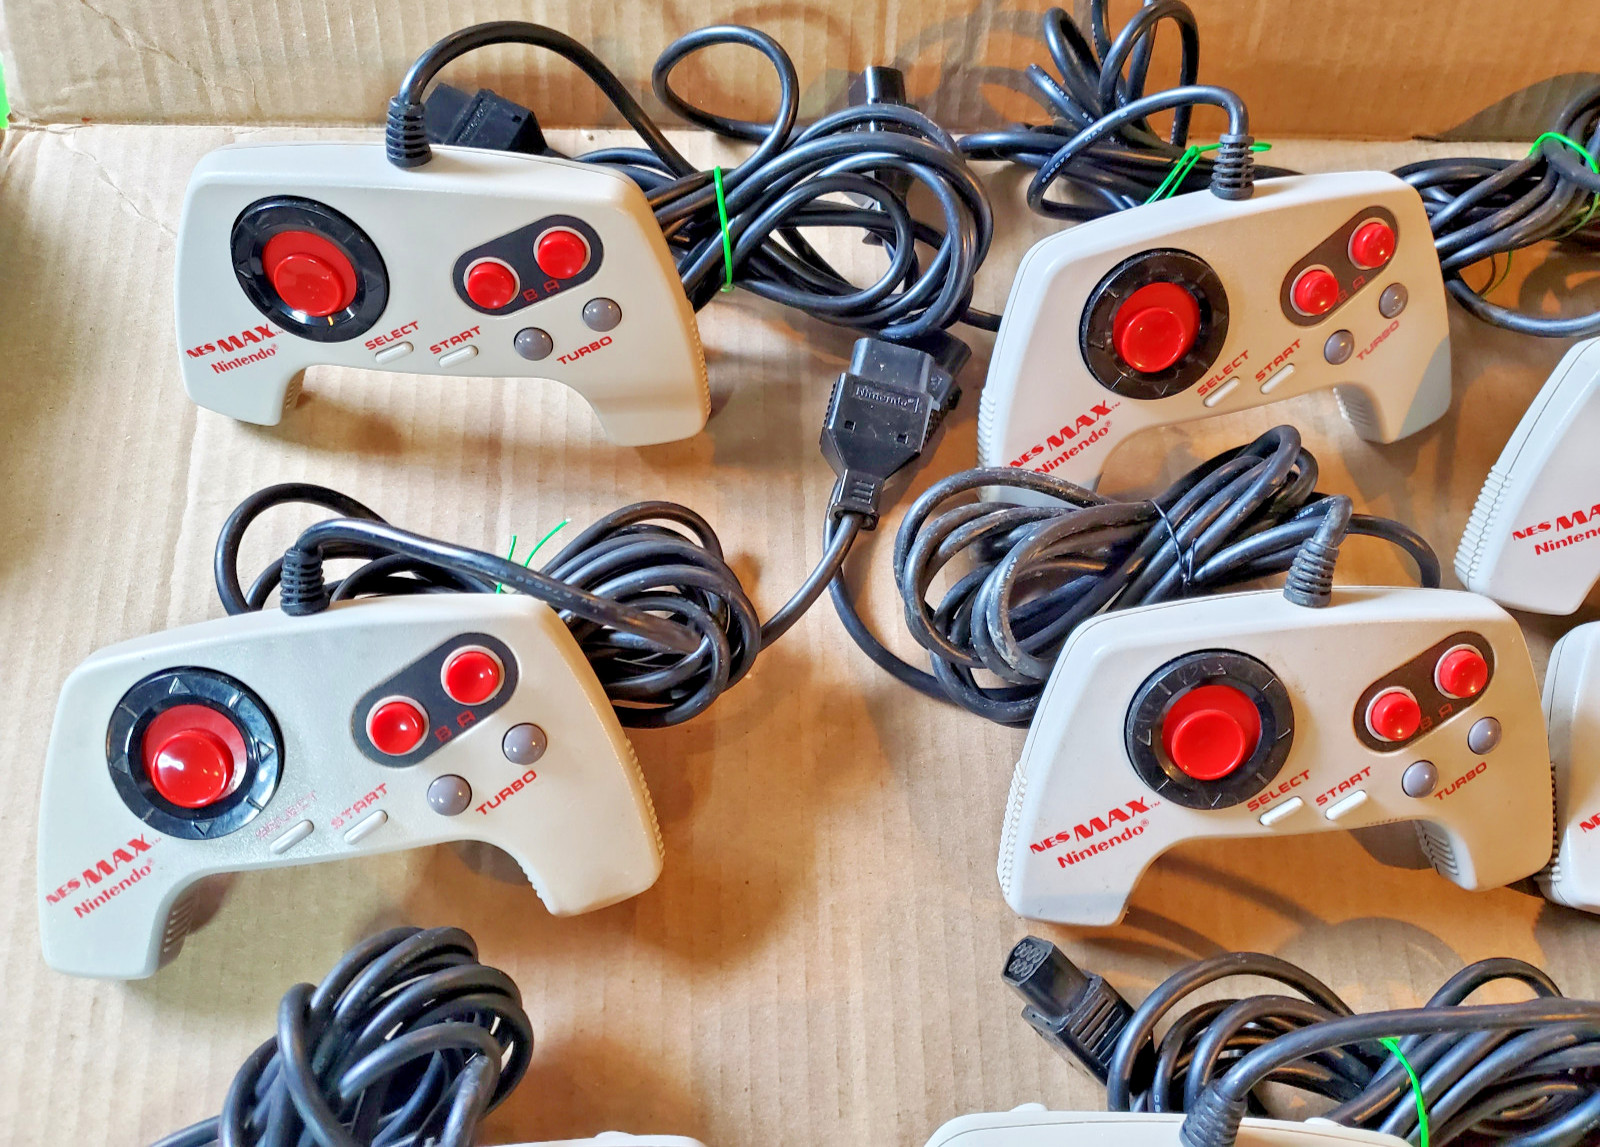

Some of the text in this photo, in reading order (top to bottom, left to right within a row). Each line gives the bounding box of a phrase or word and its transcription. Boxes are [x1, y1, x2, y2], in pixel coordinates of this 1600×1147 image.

[522, 280, 561, 302] B A
[1352, 275, 1366, 290] A
[186, 342, 216, 359] NES
[216, 323, 276, 354] MAX
[364, 320, 420, 351] SELECT
[428, 325, 481, 355] START
[556, 335, 613, 366] TURBO
[1356, 319, 1400, 361] TURBO
[1196, 350, 1249, 397] SELECT
[1255, 338, 1301, 382] START
[1006, 444, 1044, 469] NES
[1046, 400, 1112, 452] MAX
[1512, 521, 1551, 541] NES
[434, 709, 476, 743] B A
[1419, 703, 1453, 730] B A
[475, 769, 537, 816] TURBO
[1247, 769, 1310, 812] SELECT
[1314, 766, 1371, 806] START
[1434, 761, 1487, 801] TURBO
[330, 782, 388, 830] START
[1029, 830, 1070, 855] NES
[1073, 796, 1150, 842] MAX
[1579, 811, 1600, 833] NE
[45, 833, 152, 906] NES MAX
